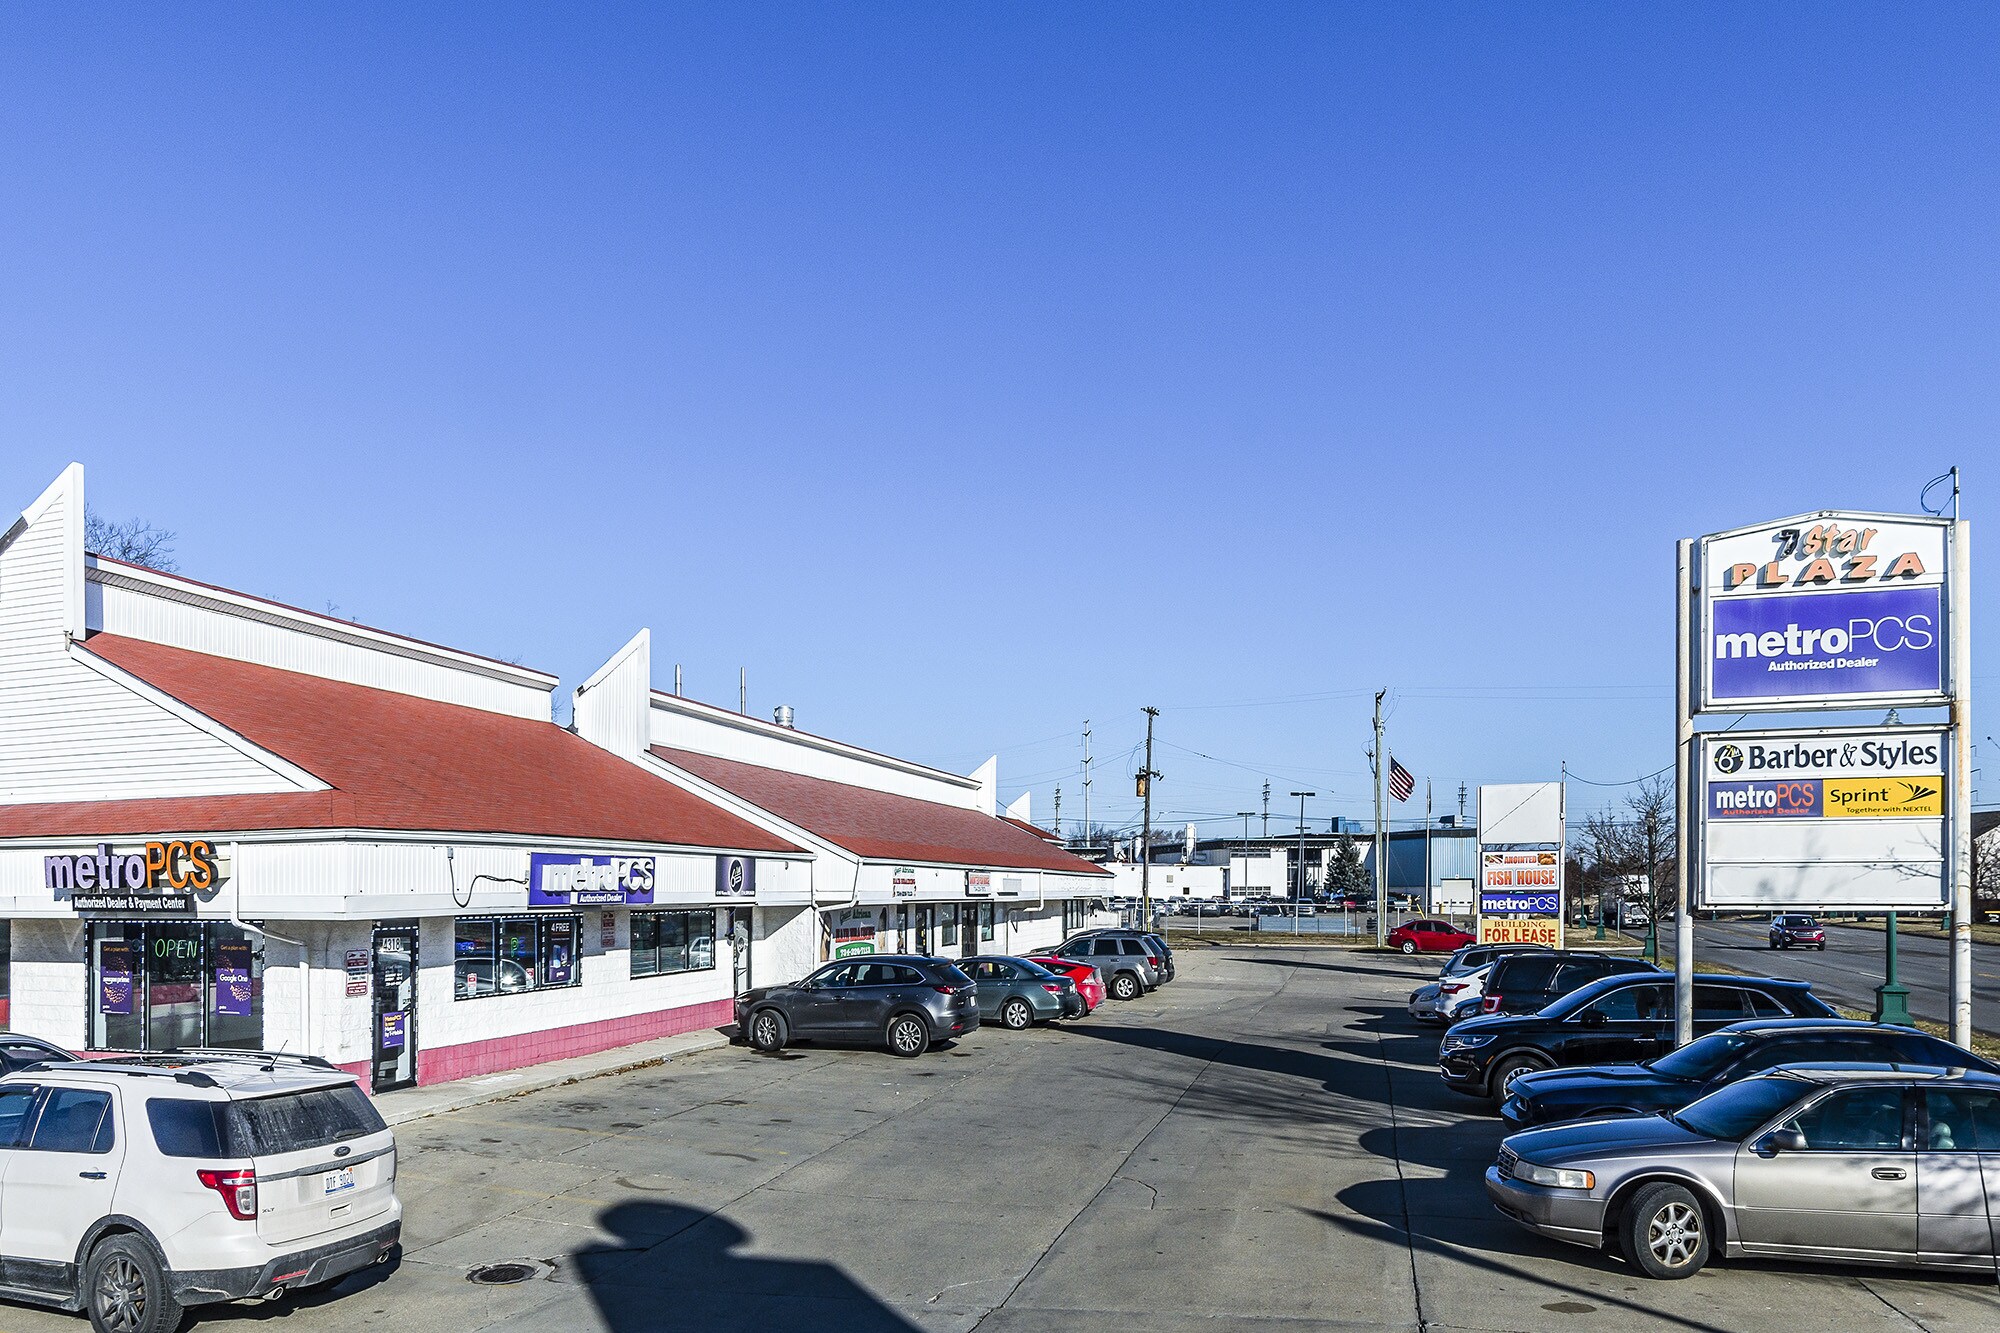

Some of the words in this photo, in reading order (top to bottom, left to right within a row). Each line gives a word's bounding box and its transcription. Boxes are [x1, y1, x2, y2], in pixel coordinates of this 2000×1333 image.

[1797, 523, 1878, 560] Star
[1724, 552, 1926, 590] PLAZA
[1715, 614, 1934, 660] metroPCS
[1767, 659, 1835, 672] Authorized
[1836, 657, 1879, 669] Dealer
[1748, 744, 1838, 770] Barber
[1839, 742, 1858, 767] &
[1860, 740, 1938, 769] Styles
[1716, 783, 1815, 809] metroPCS
[1830, 788, 1889, 806] Sprint
[44, 841, 213, 890] metroPCS
[1504, 855, 1537, 864] ANOINTED
[541, 857, 655, 891] metroPCS
[1487, 870, 1513, 885] FISH
[1516, 869, 1556, 885] HOUSE
[74, 896, 107, 909] Authorized
[107, 897, 128, 909] Dealer
[128, 898, 134, 909] &
[134, 898, 162, 912] Payment
[162, 898, 186, 910] Center
[579, 894, 607, 903] Authorized
[607, 894, 624, 902] Dealer
[556, 923, 570, 931] FREE
[1484, 928, 1511, 942] FOR
[1514, 928, 1556, 942] LEASE
[155, 938, 198, 958] OPEN
[383, 939, 401, 951] 4318
[220, 974, 237, 984] Google
